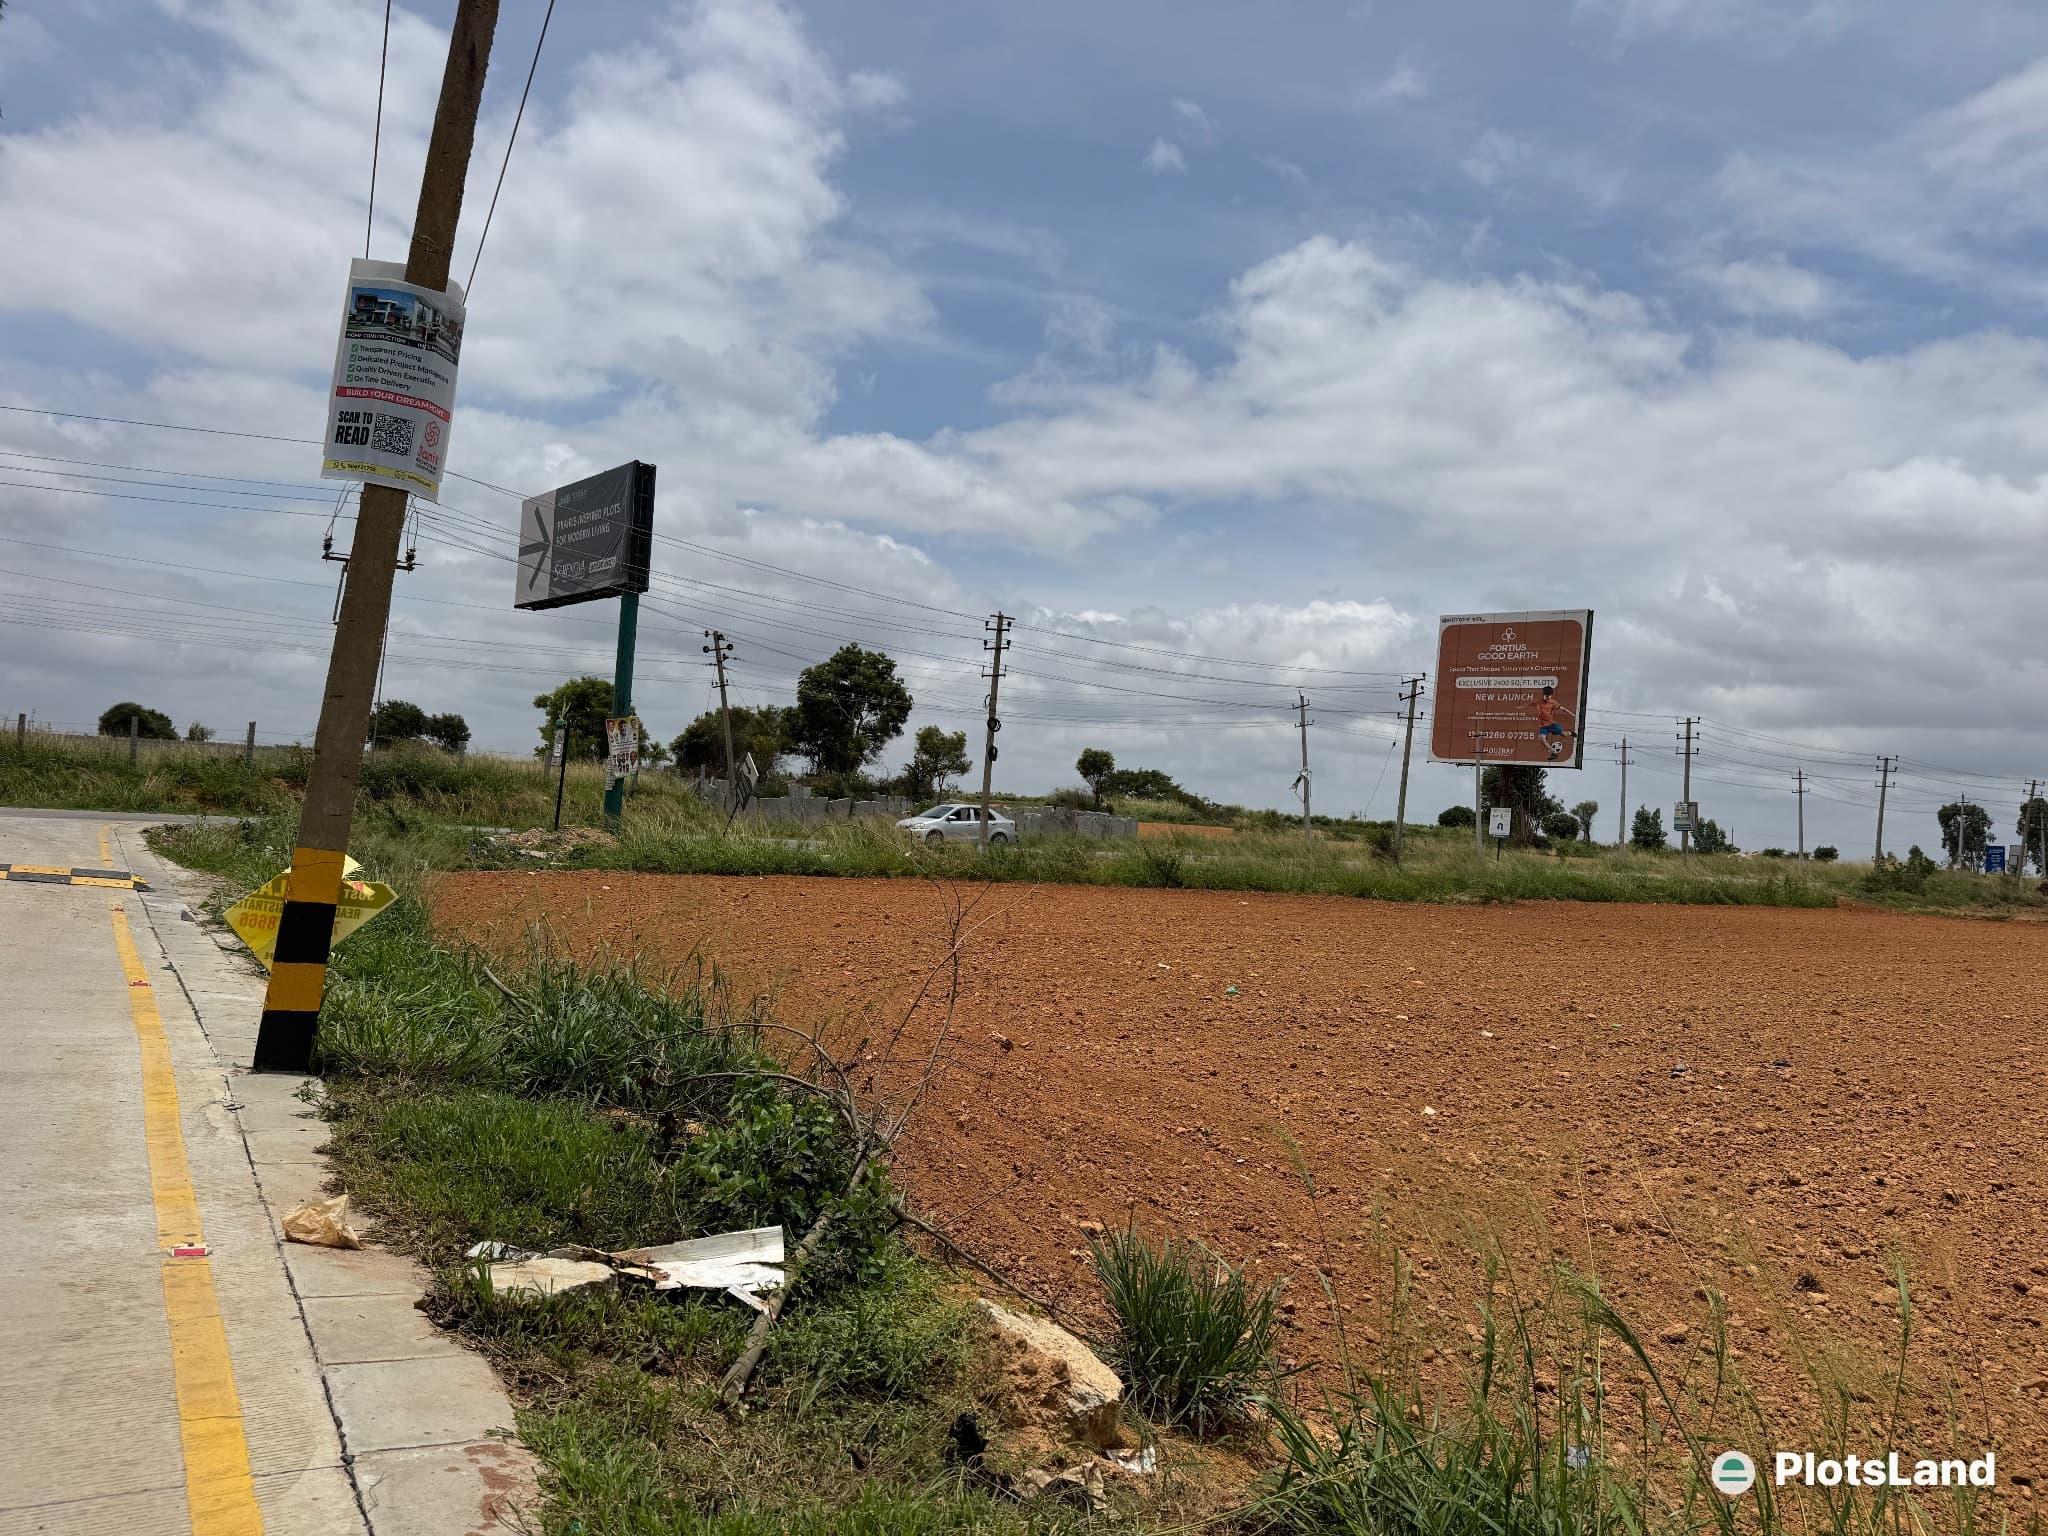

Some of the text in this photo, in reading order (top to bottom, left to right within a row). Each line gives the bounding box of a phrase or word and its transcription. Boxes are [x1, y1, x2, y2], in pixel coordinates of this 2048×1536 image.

[360, 345, 422, 363] Transparent Pricing
[357, 355, 389, 364] Dedicated
[390, 359, 416, 371] Project
[355, 365, 436, 388] Quality Driven Execution
[380, 378, 411, 391] Delivery
[346, 388, 369, 397] BUILD
[370, 391, 395, 401] YOUR
[396, 395, 429, 409] DREAM
[338, 410, 373, 425] SCAN TO
[334, 425, 370, 446] READ
[603, 502, 621, 517] PLOTS
[556, 521, 610, 547] FOR MODERN LIVING
[1477, 651, 1539, 660] GOOD EARTH
[1489, 644, 1527, 652] FORTIUS
[1458, 679, 1492, 687] EXCLUSIVE
[1475, 693, 1534, 701] NEW LAUNCH
[1507, 731, 1535, 740] 07755
